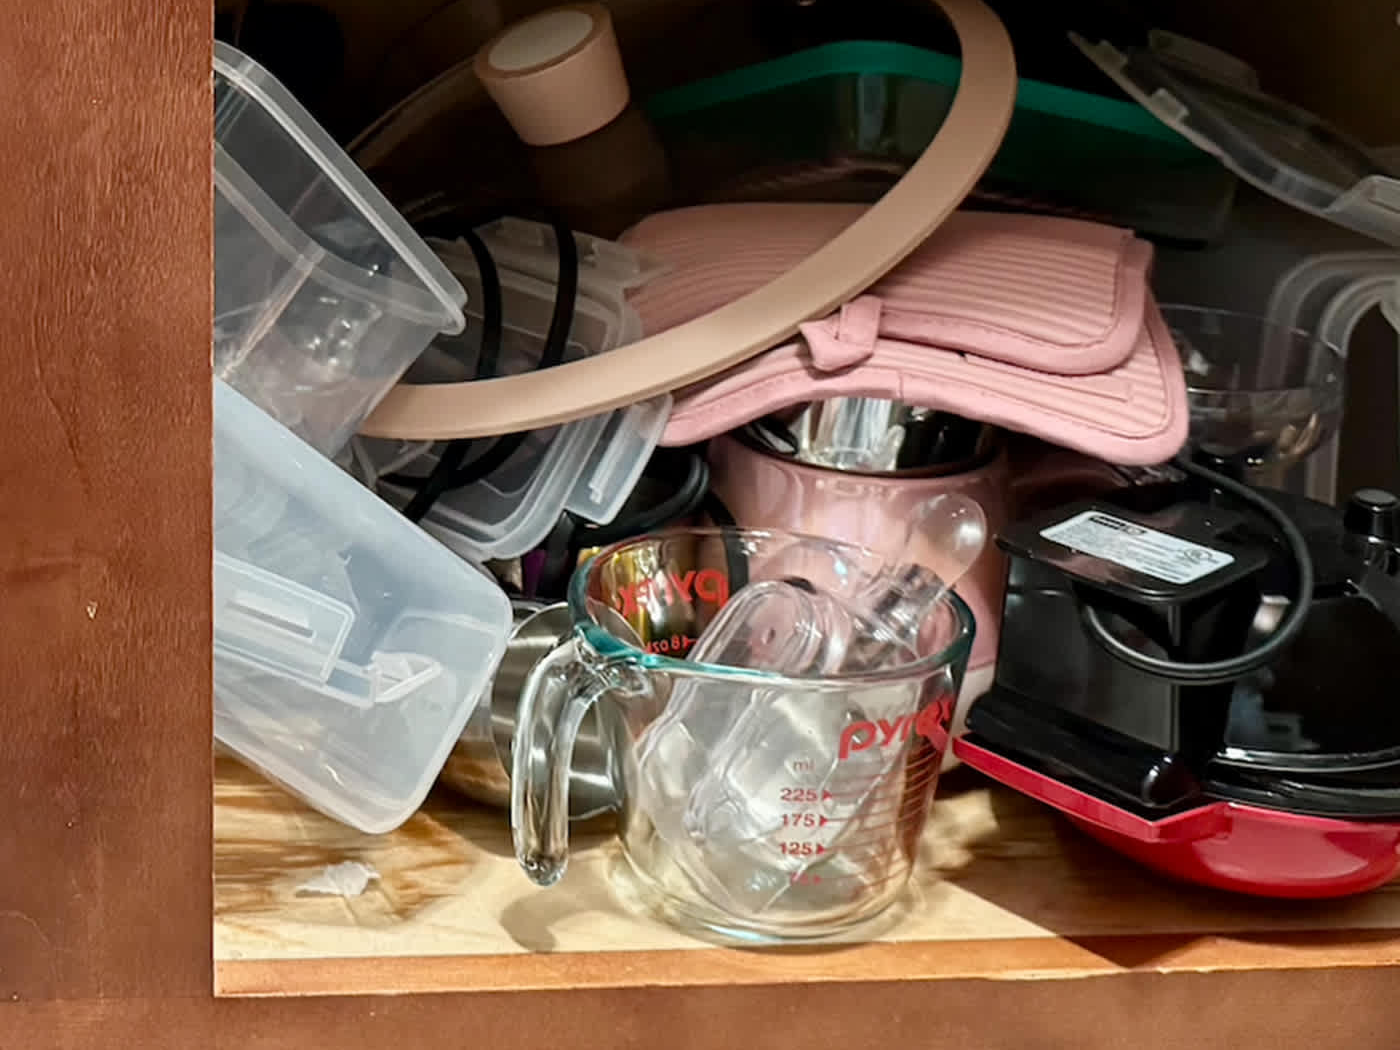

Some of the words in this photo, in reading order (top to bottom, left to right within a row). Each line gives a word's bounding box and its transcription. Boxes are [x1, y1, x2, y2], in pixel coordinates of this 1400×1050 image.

[780, 787, 818, 802] 225
[782, 813, 816, 828] 175
[780, 841, 813, 855] 125
